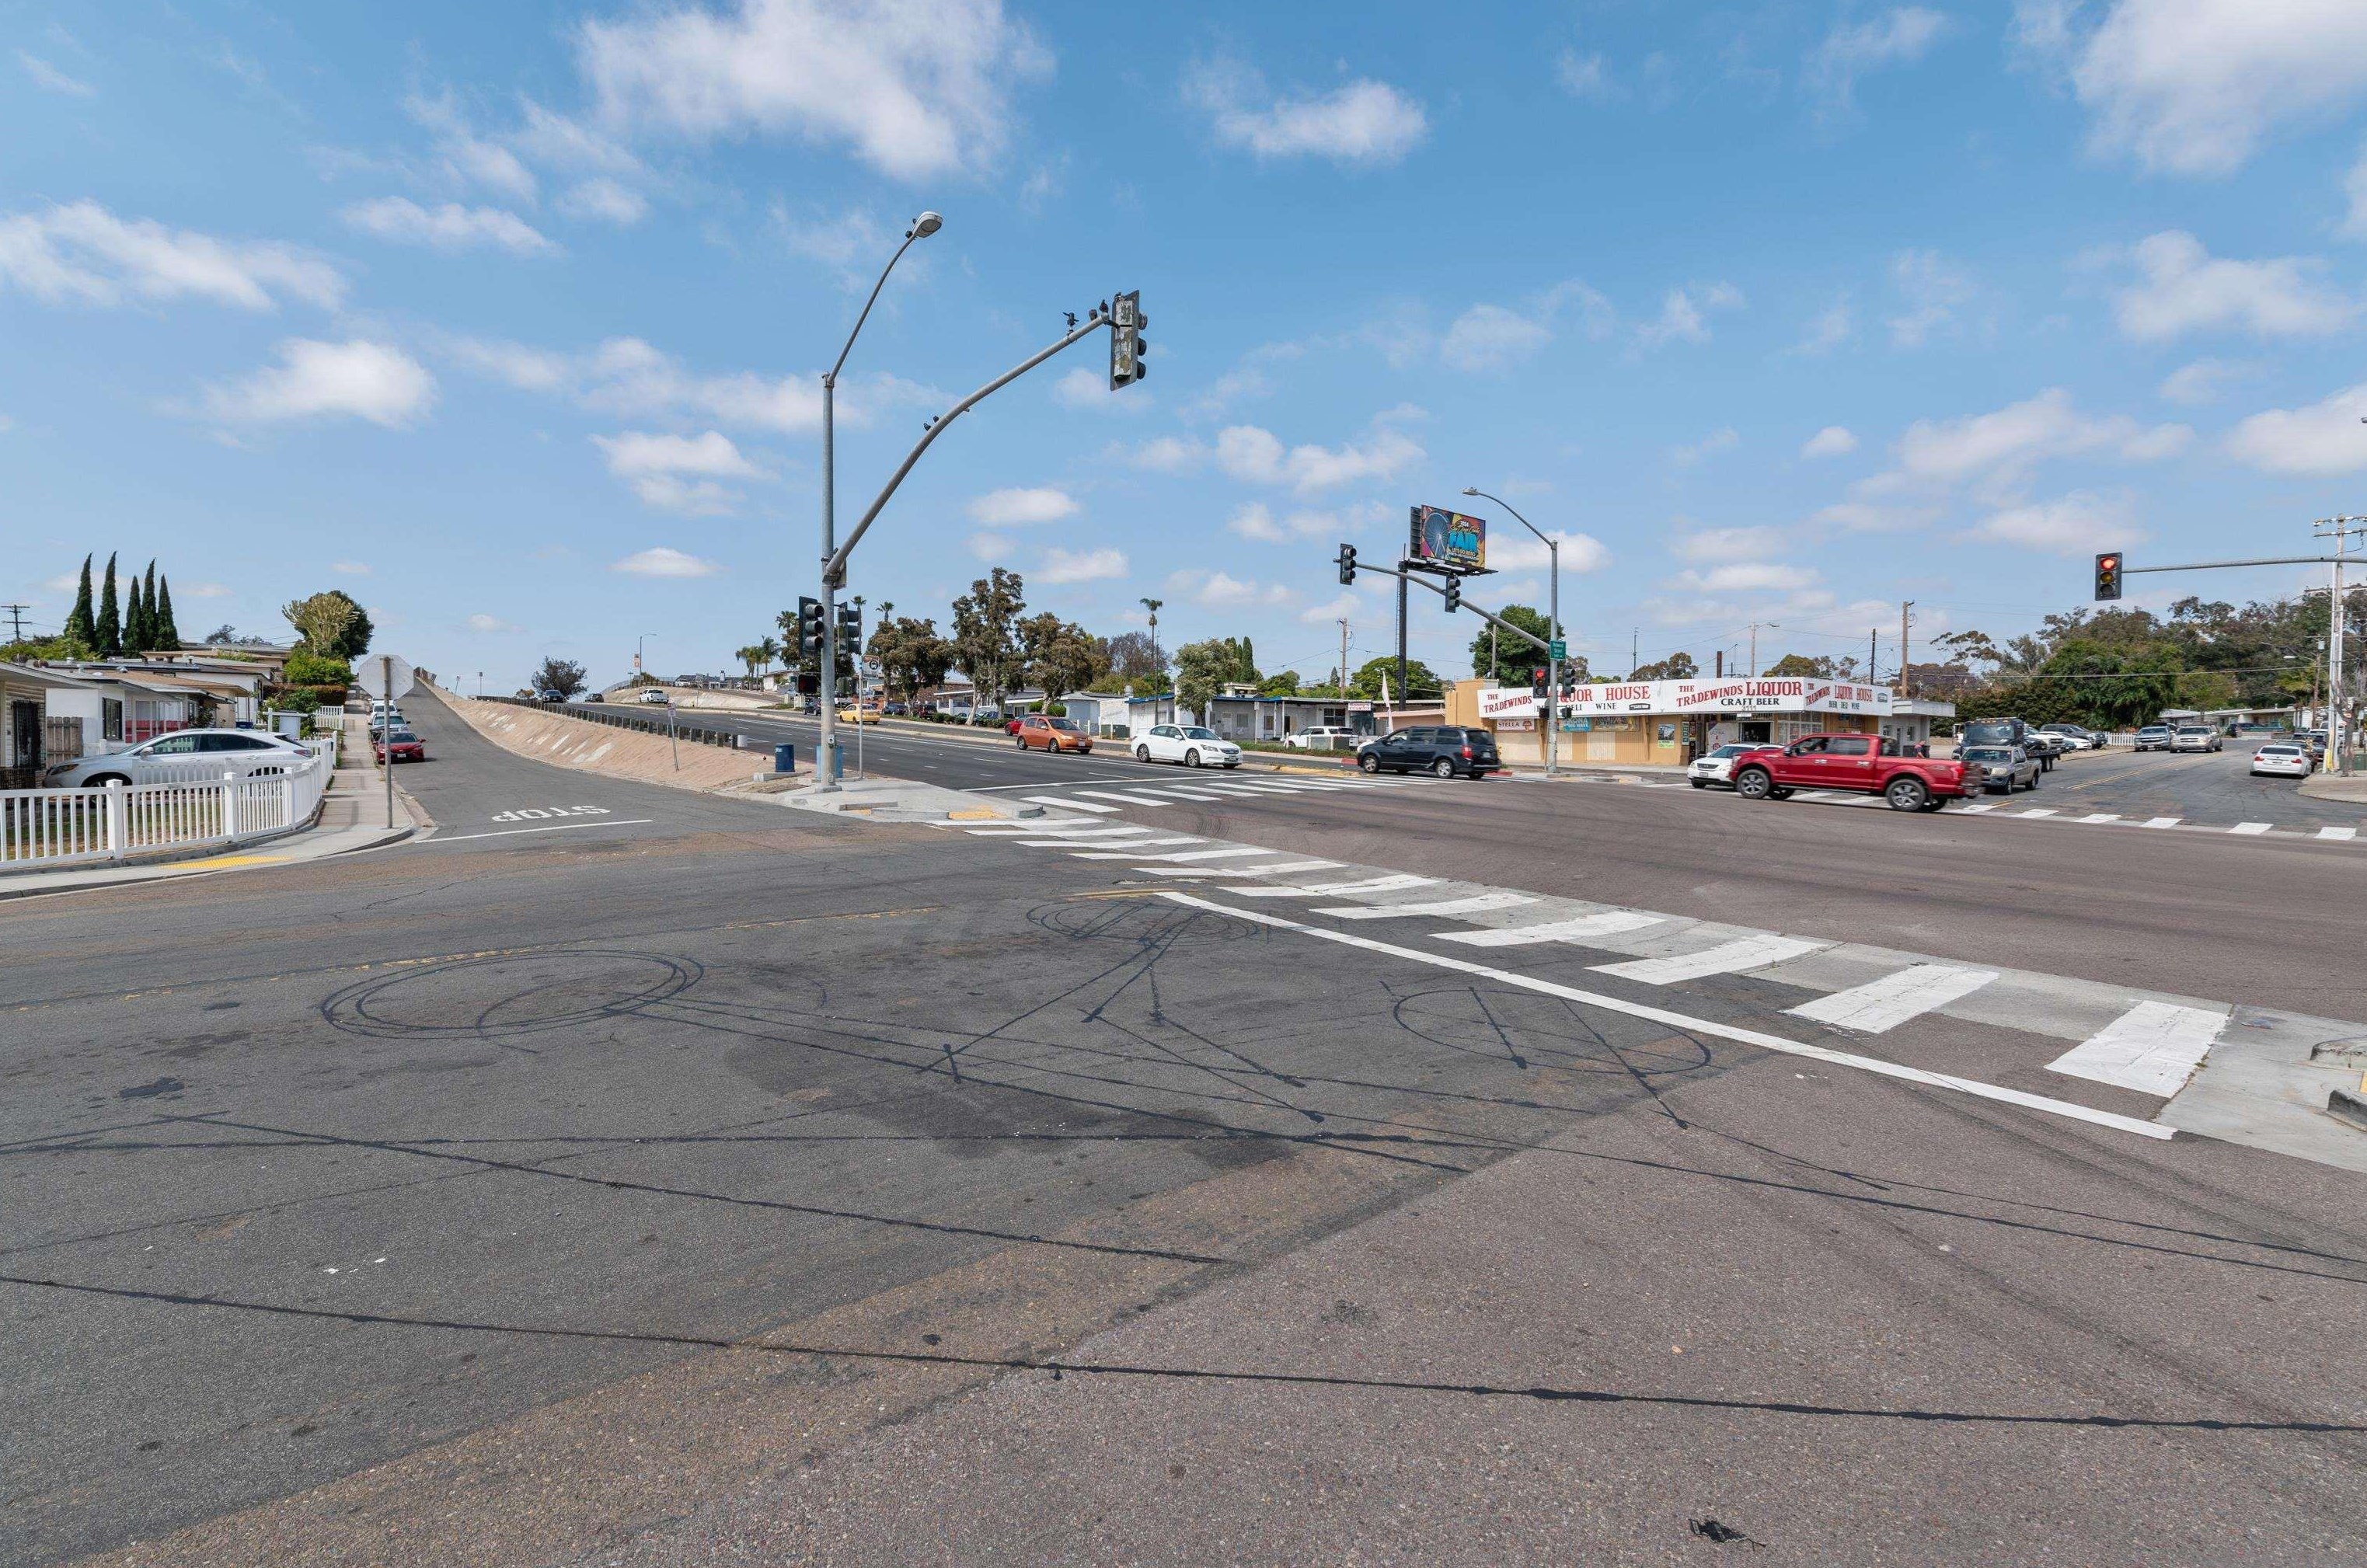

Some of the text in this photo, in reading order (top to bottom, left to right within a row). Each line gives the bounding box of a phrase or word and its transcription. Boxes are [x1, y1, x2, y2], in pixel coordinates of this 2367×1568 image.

[1605, 685, 1651, 701] HOUSE
[1676, 681, 1802, 707] TRADEWINDS LIQUOR
[1805, 686, 1830, 706] TRADEWINDS
[1835, 685, 1853, 700] LIQUOR
[1856, 688, 1873, 702] HOUSE
[1483, 696, 1532, 713] TRADEWINDS
[491, 806, 612, 821] STOP
